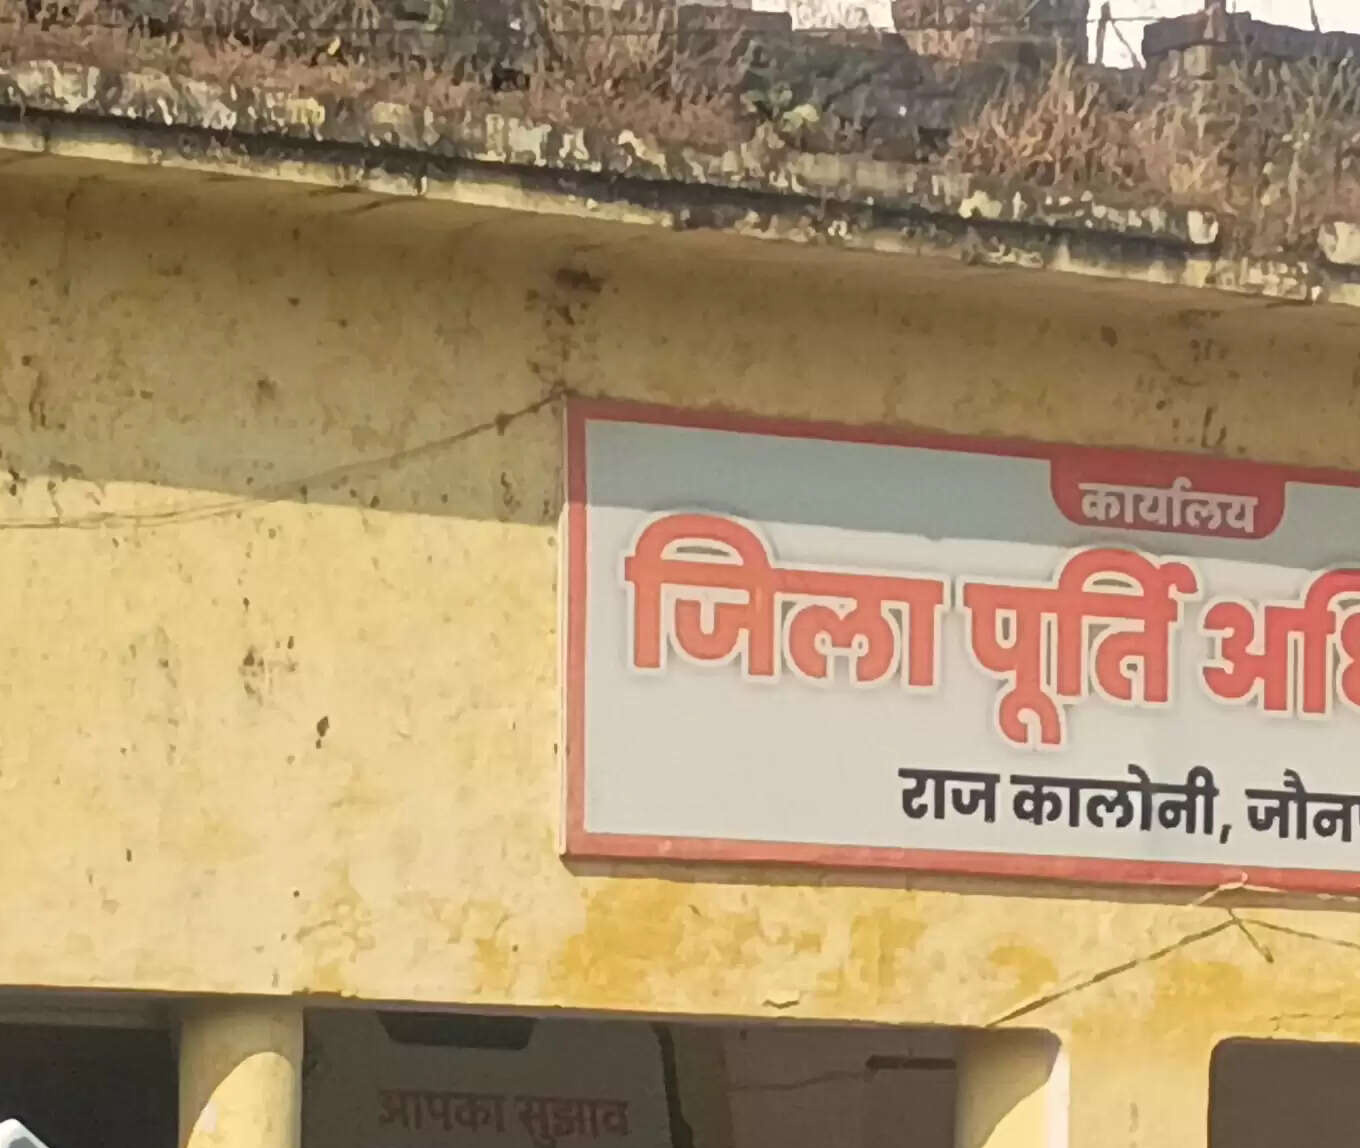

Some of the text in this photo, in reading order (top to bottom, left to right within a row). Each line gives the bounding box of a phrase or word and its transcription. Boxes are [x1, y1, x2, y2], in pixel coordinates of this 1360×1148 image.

[1078, 476, 1259, 534] कार्यालय
[624, 512, 944, 687] जिला
[962, 547, 1198, 746] पूर्ति
[897, 767, 1001, 824] राज
[1009, 763, 1232, 845] कालोनी,
[377, 1089, 632, 1148] आपका सुझाव
